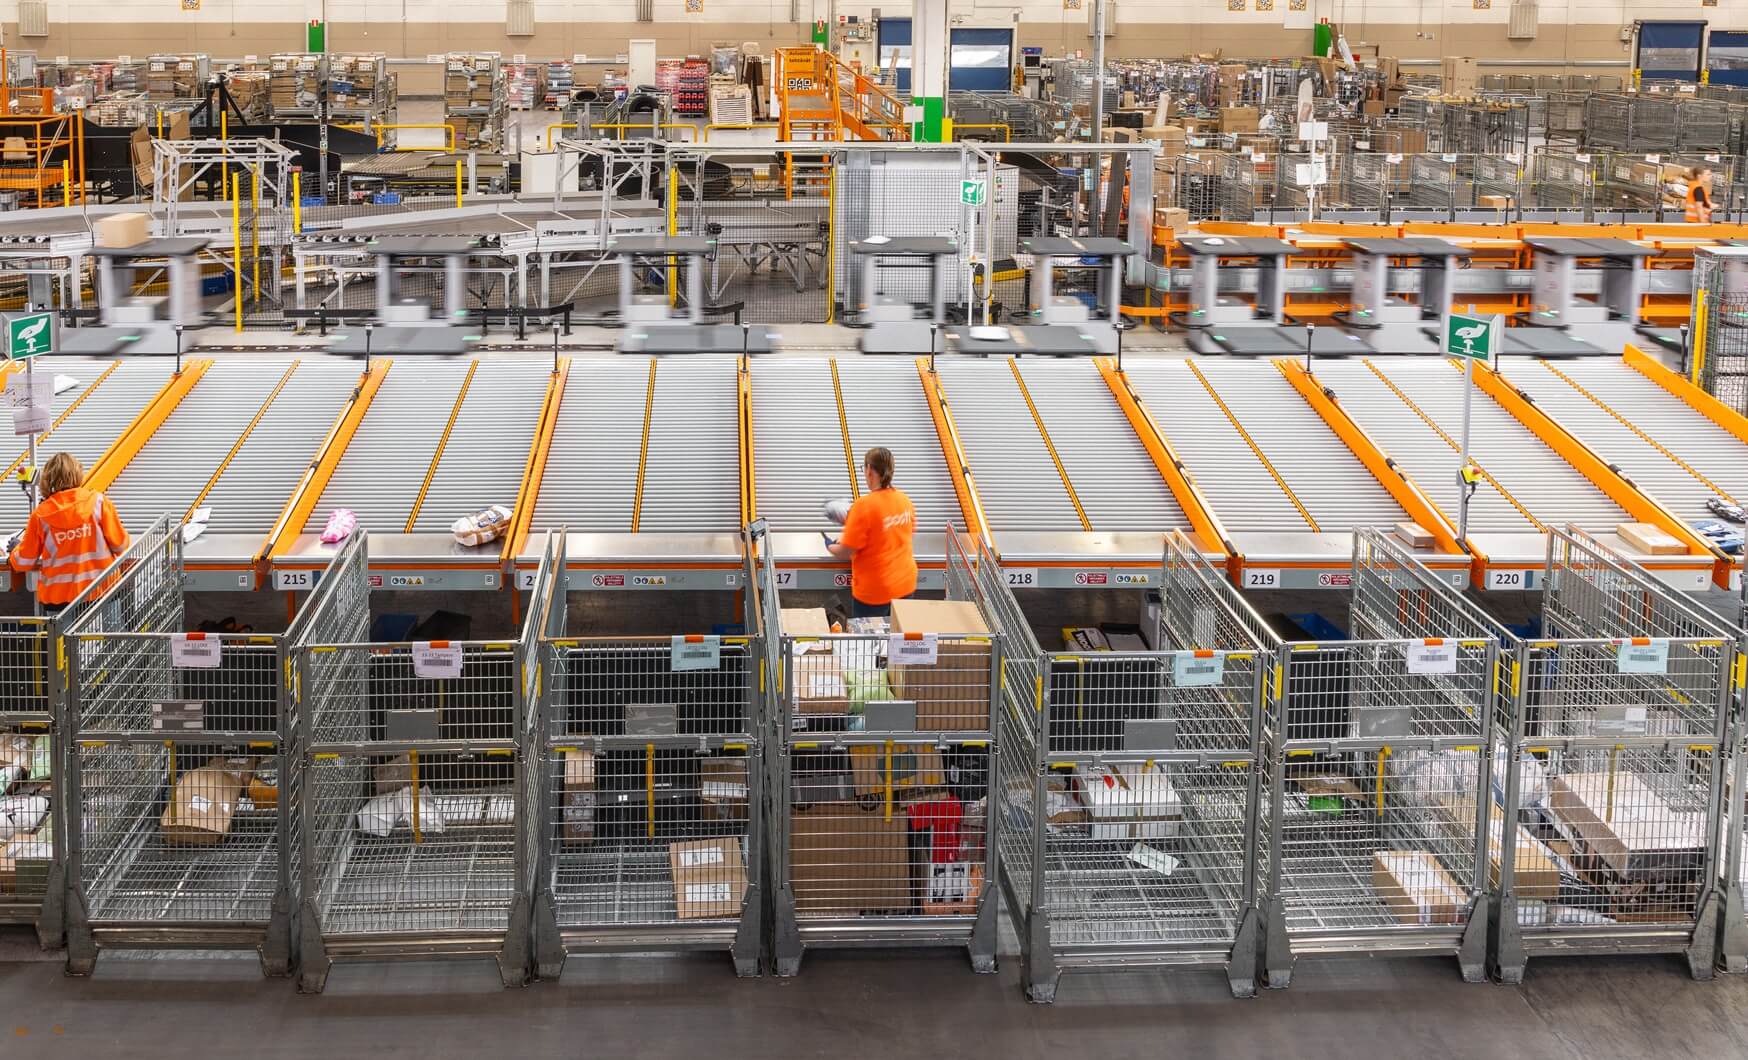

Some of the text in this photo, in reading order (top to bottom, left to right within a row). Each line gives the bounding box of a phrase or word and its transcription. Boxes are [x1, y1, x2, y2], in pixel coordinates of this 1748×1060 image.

[54, 523, 92, 544] posti
[283, 574, 306, 585] 215
[776, 573, 791, 584] 17
[1008, 573, 1032, 584] 218
[1250, 574, 1275, 585] 219
[1495, 573, 1519, 585] 220
